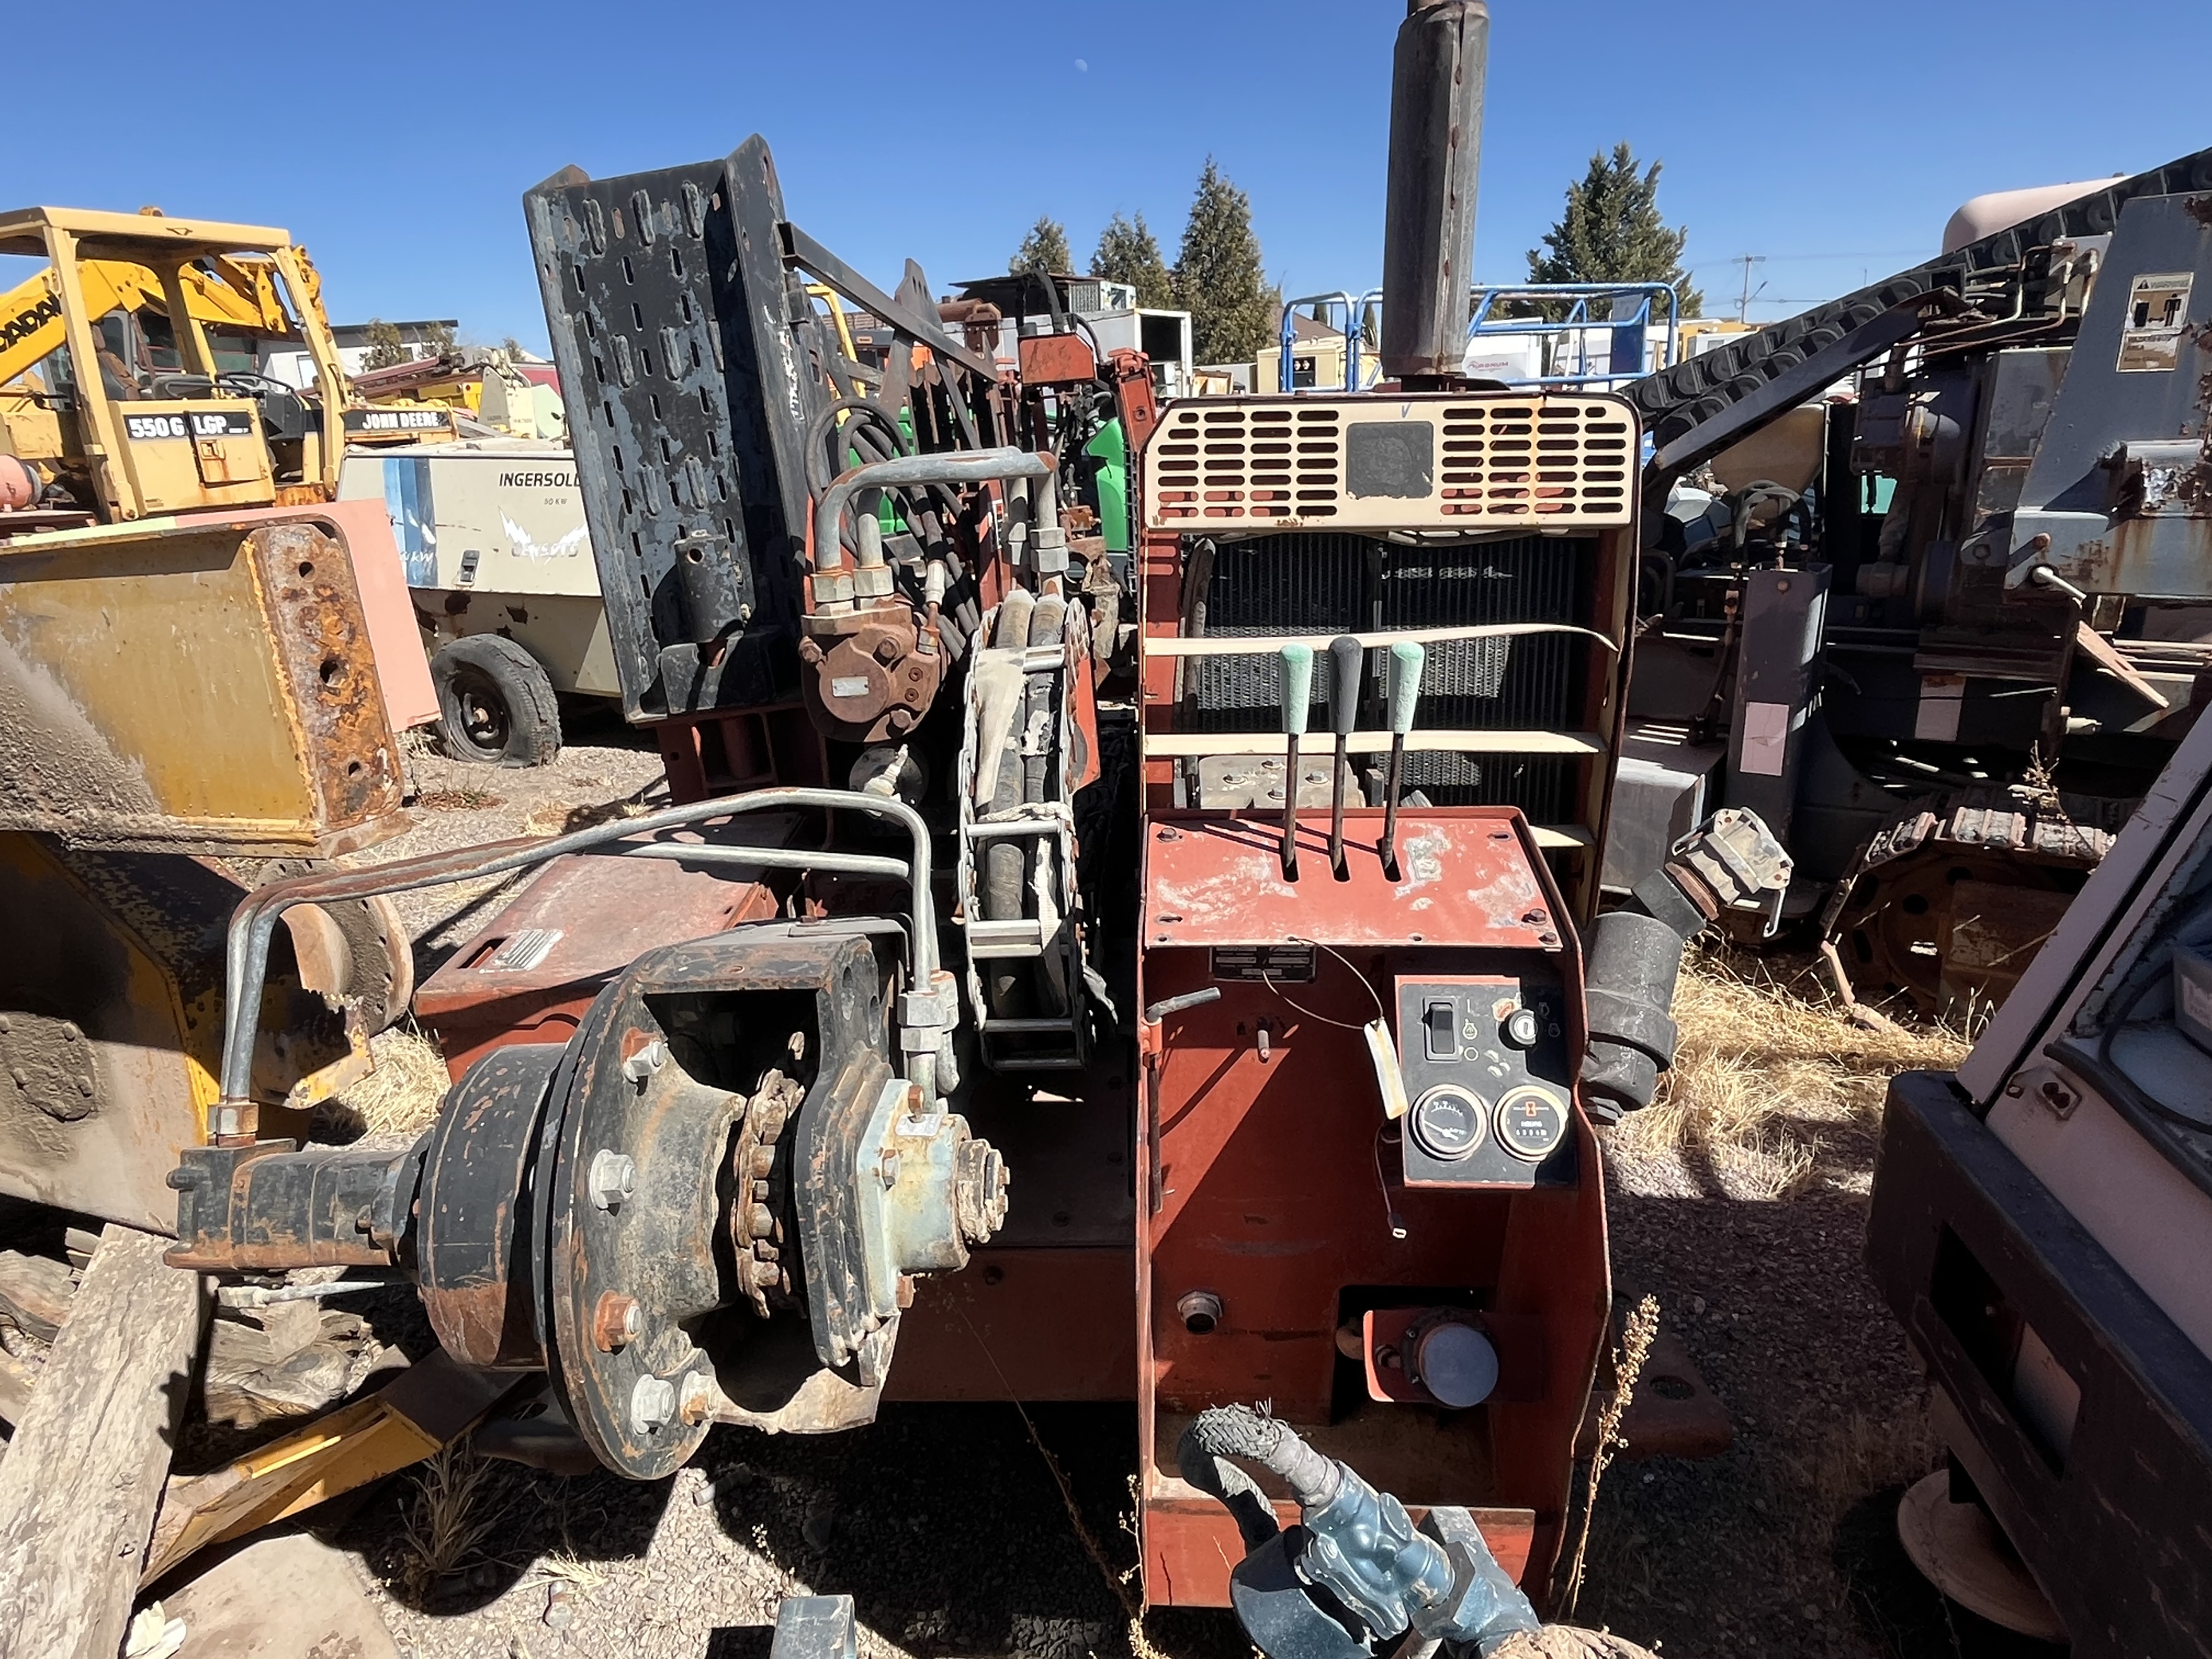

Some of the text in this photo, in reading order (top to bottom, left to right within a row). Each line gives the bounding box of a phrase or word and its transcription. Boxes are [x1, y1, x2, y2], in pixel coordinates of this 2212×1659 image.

[193, 415, 227, 435] LGP
[362, 411, 439, 429] JOHN DEERE
